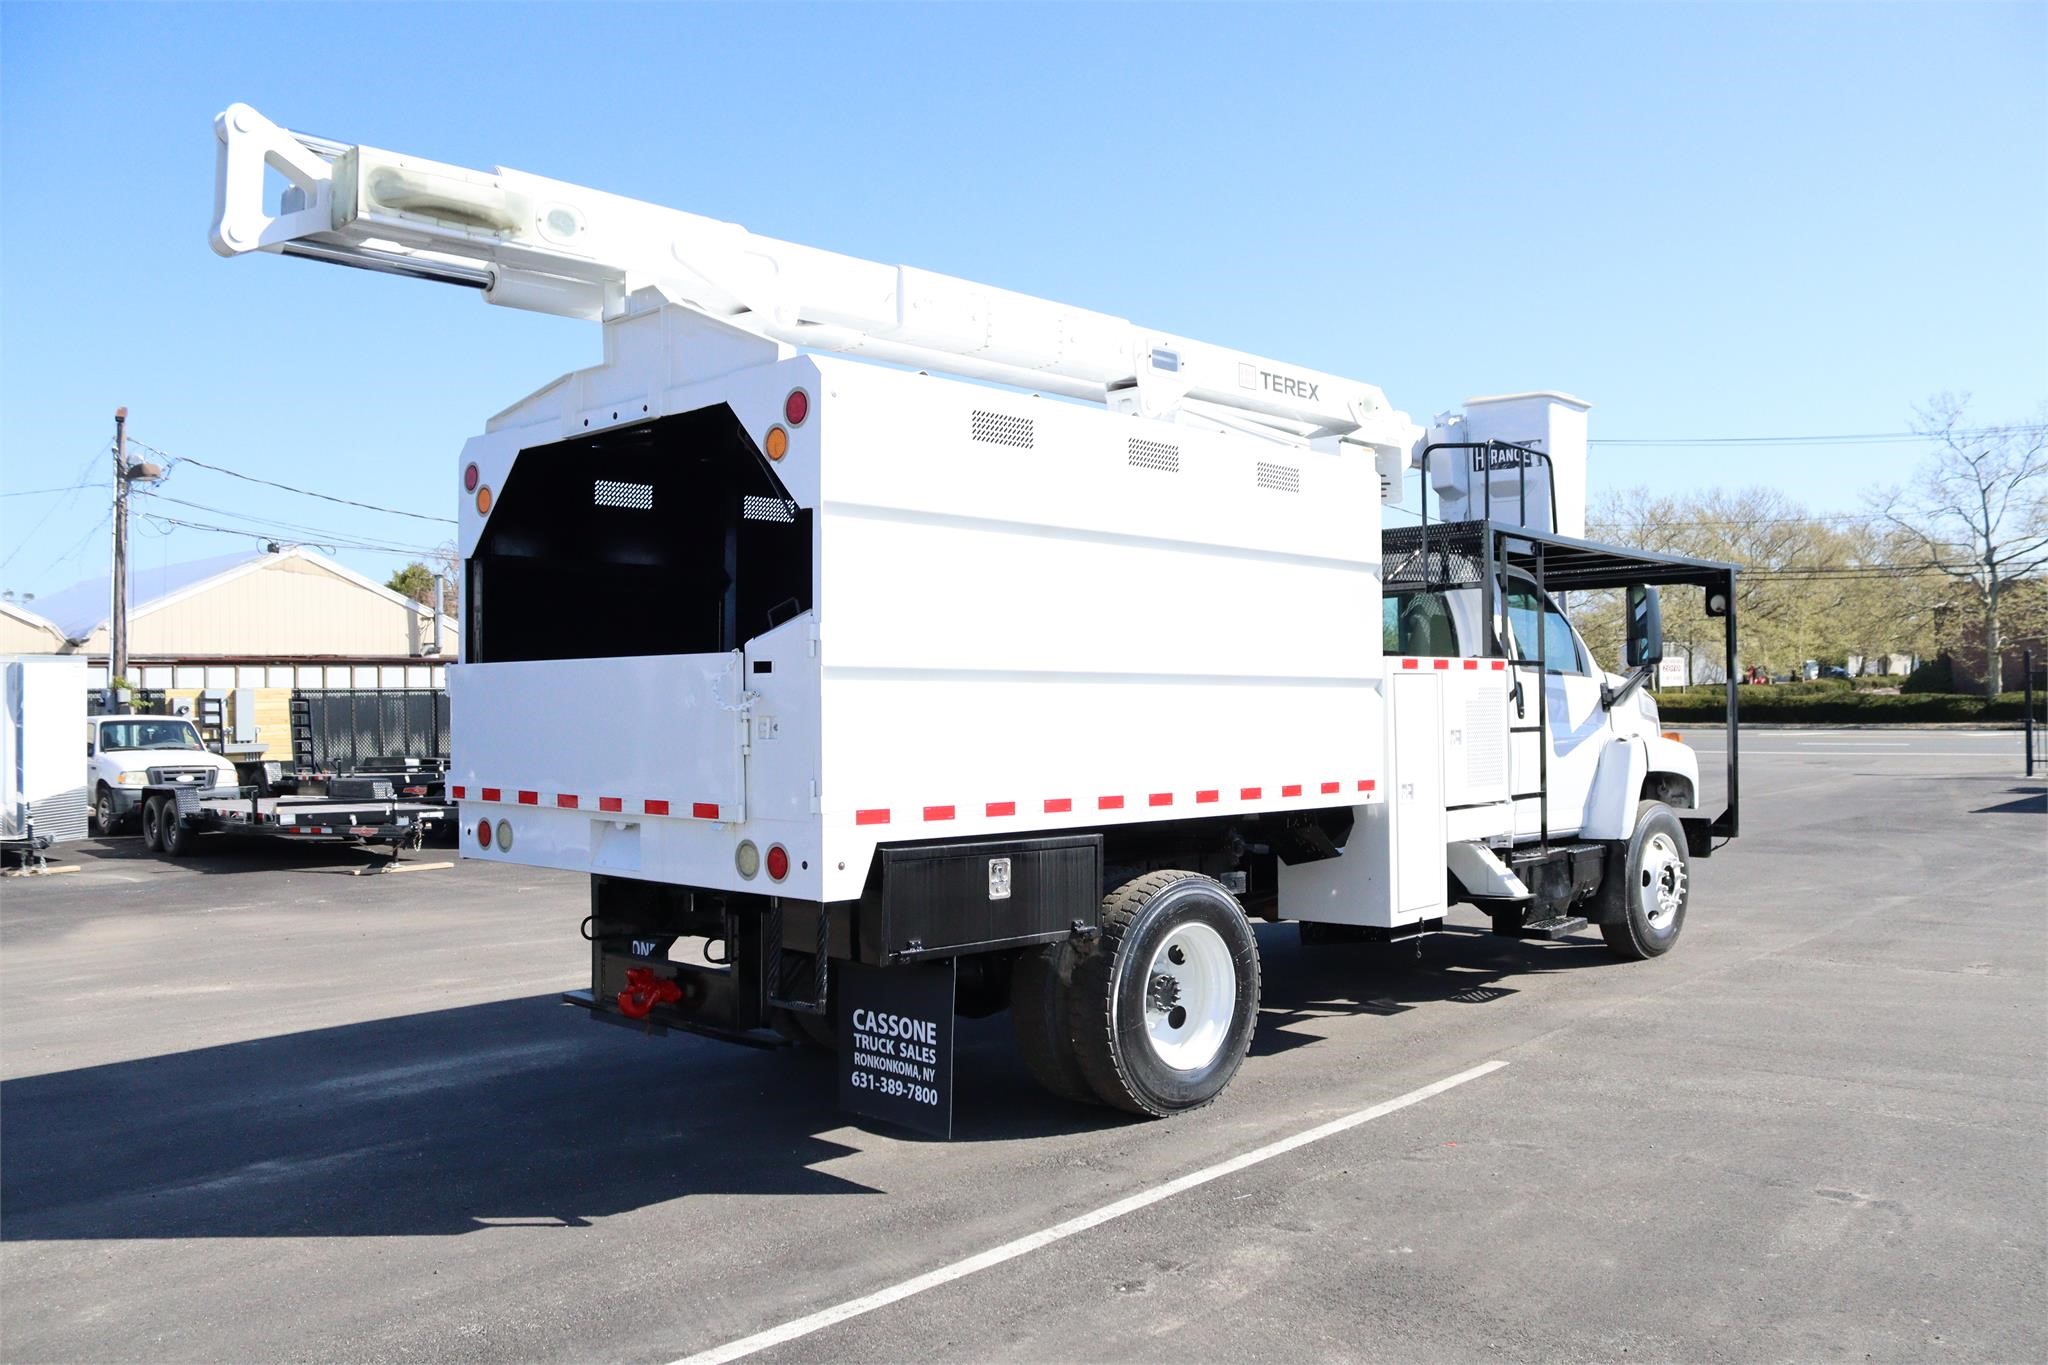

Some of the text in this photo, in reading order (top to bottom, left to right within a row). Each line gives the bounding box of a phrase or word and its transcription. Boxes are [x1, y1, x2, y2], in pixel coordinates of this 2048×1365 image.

[1260, 371, 1319, 402] TEREX
[853, 1009, 937, 1045] CASSONE
[853, 1033, 936, 1064] TRUCK SALES
[854, 1052, 936, 1083] RONKONKOMA, NY
[851, 1071, 938, 1106] 631-389-7800
